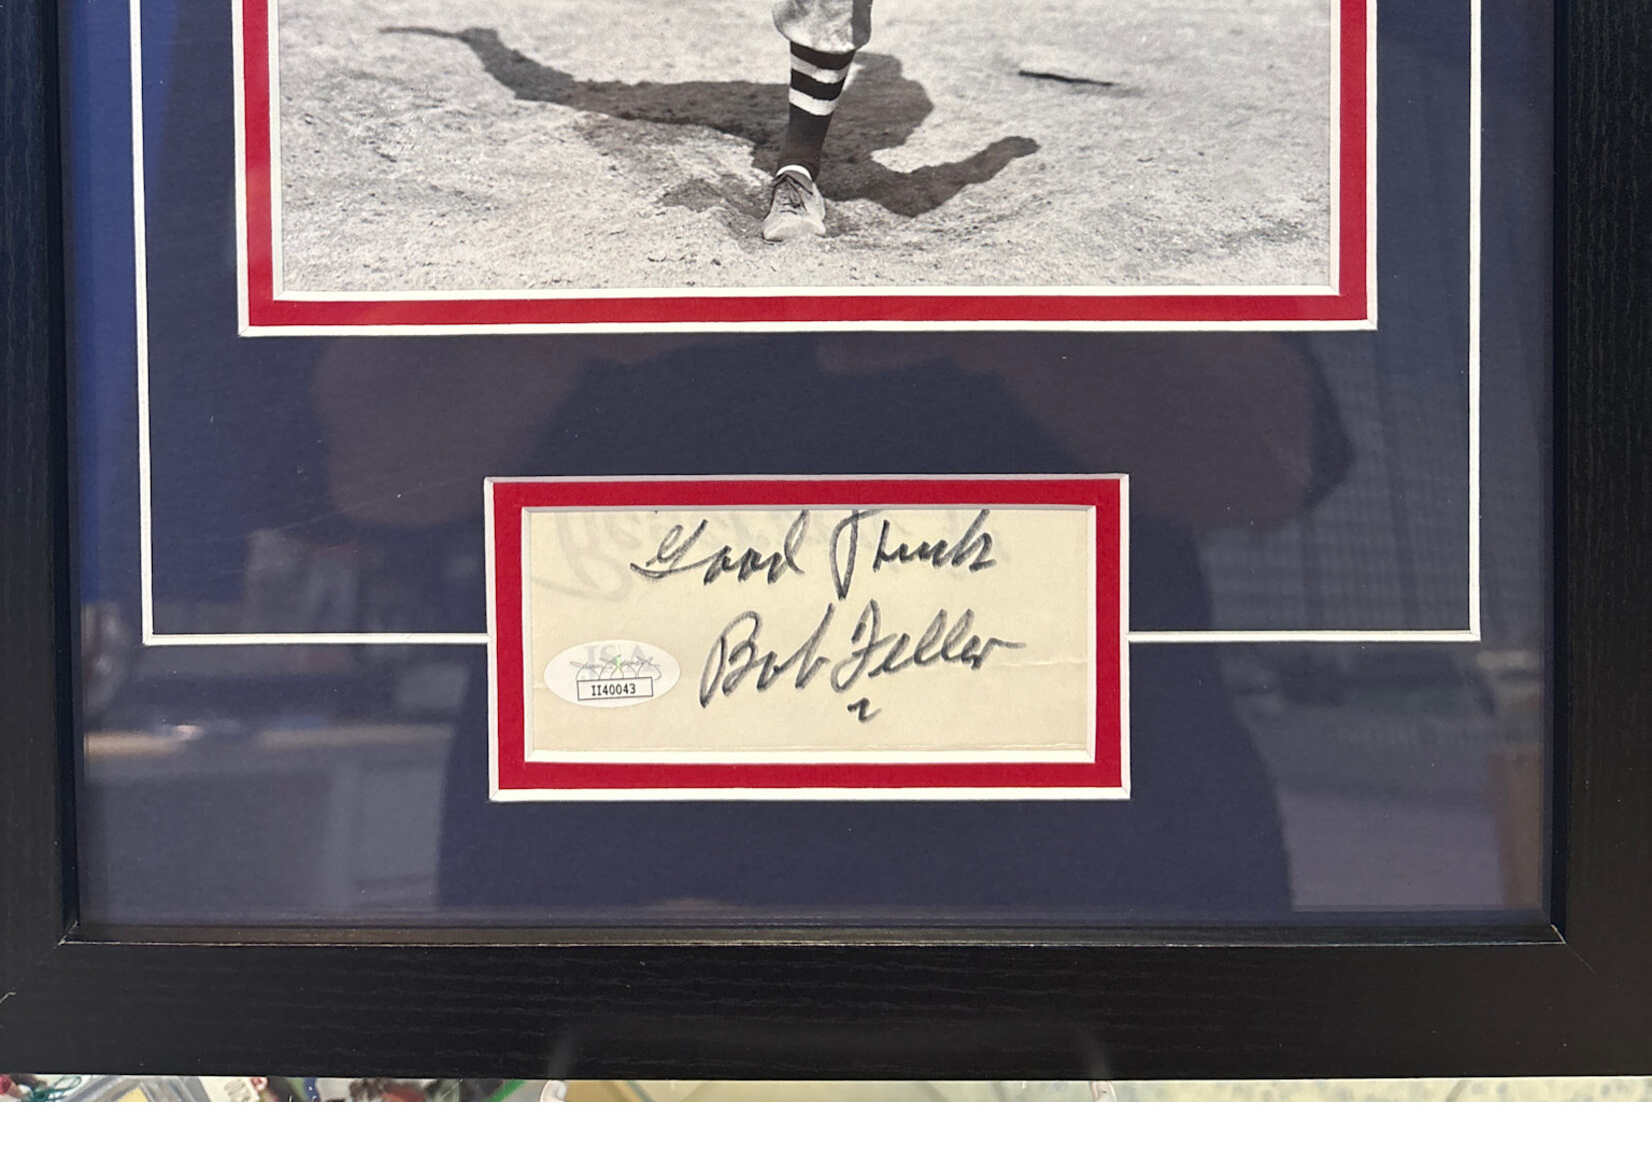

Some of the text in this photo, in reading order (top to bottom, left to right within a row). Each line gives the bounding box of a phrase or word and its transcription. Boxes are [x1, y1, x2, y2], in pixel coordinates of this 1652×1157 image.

[630, 510, 808, 586] Good
[699, 598, 1027, 709] Bob Feller
